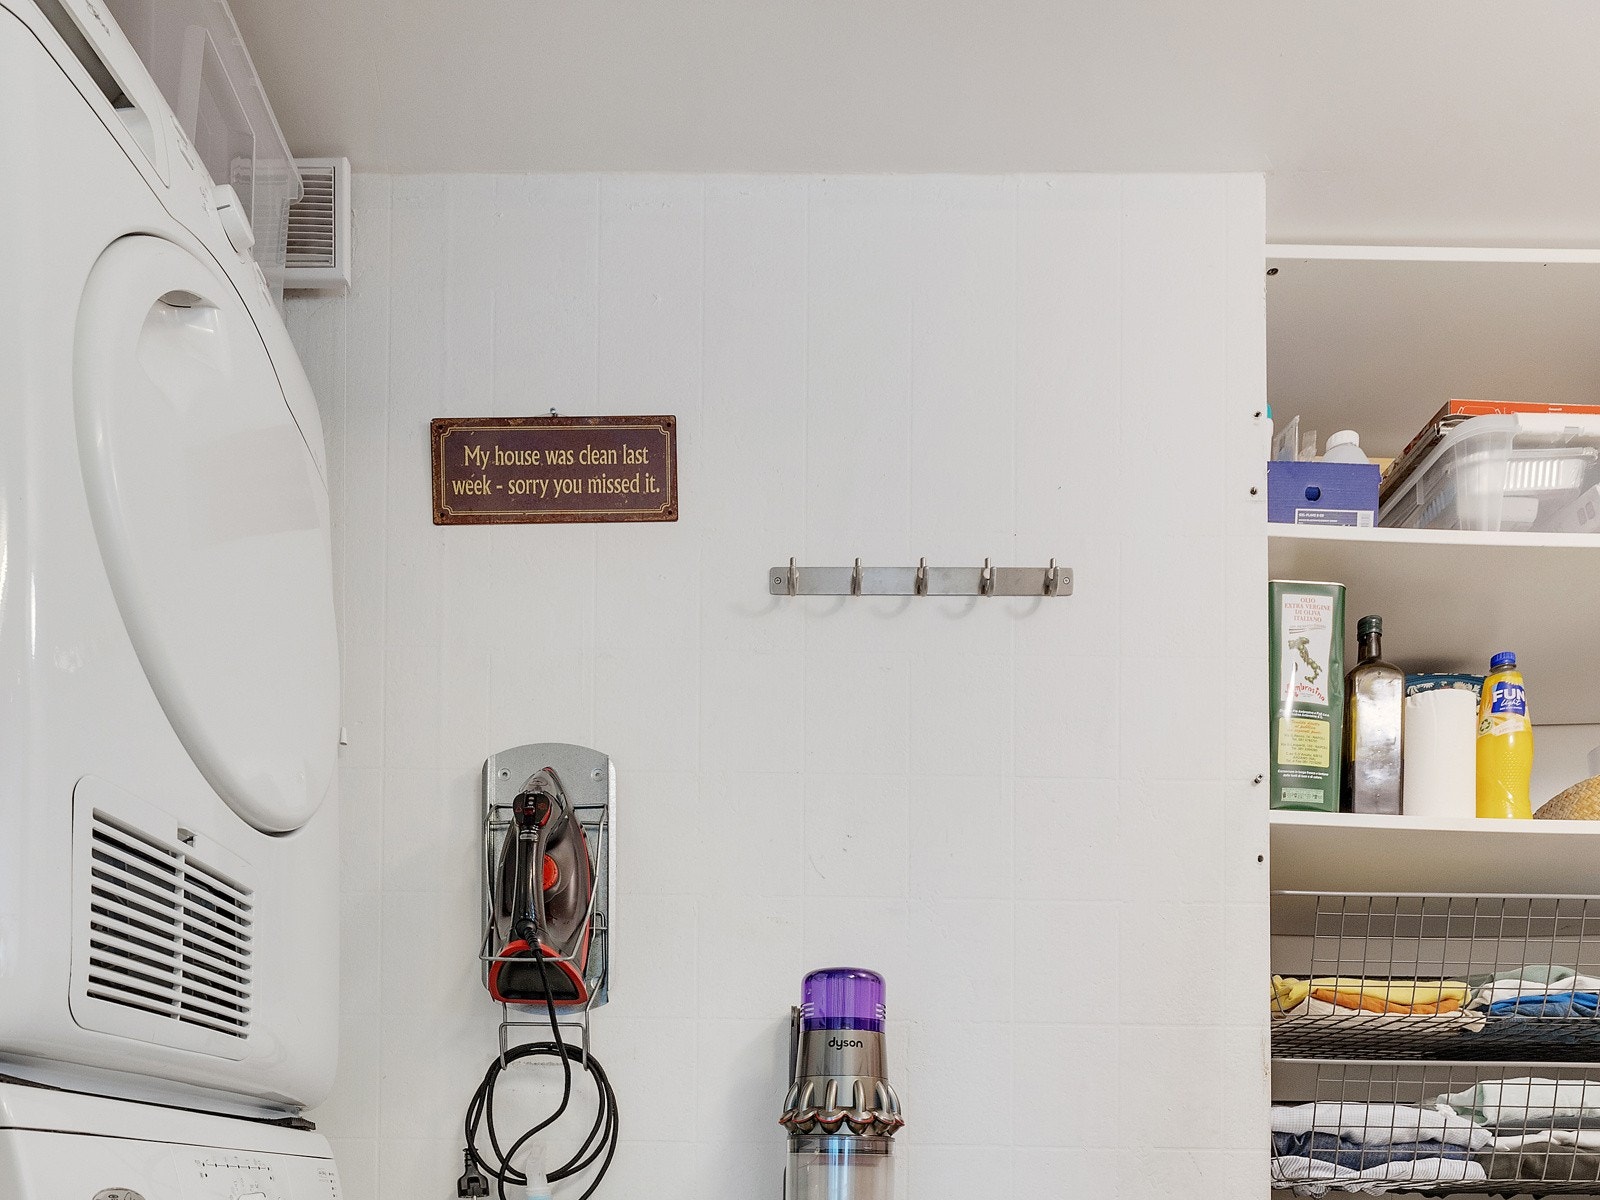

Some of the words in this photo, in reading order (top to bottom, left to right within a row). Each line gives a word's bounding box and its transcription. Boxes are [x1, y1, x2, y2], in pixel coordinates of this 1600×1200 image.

[463, 445, 490, 469] My
[495, 445, 540, 466] house
[545, 449, 574, 465] was
[579, 444, 618, 465] clean
[622, 444, 649, 465] last
[452, 475, 491, 495] week
[508, 478, 549, 498] sorry
[553, 478, 582, 498] you
[588, 473, 640, 494] missed
[645, 473, 661, 493] it.
[1492, 688, 1526, 702] FUN
[828, 1036, 863, 1050] dyson
